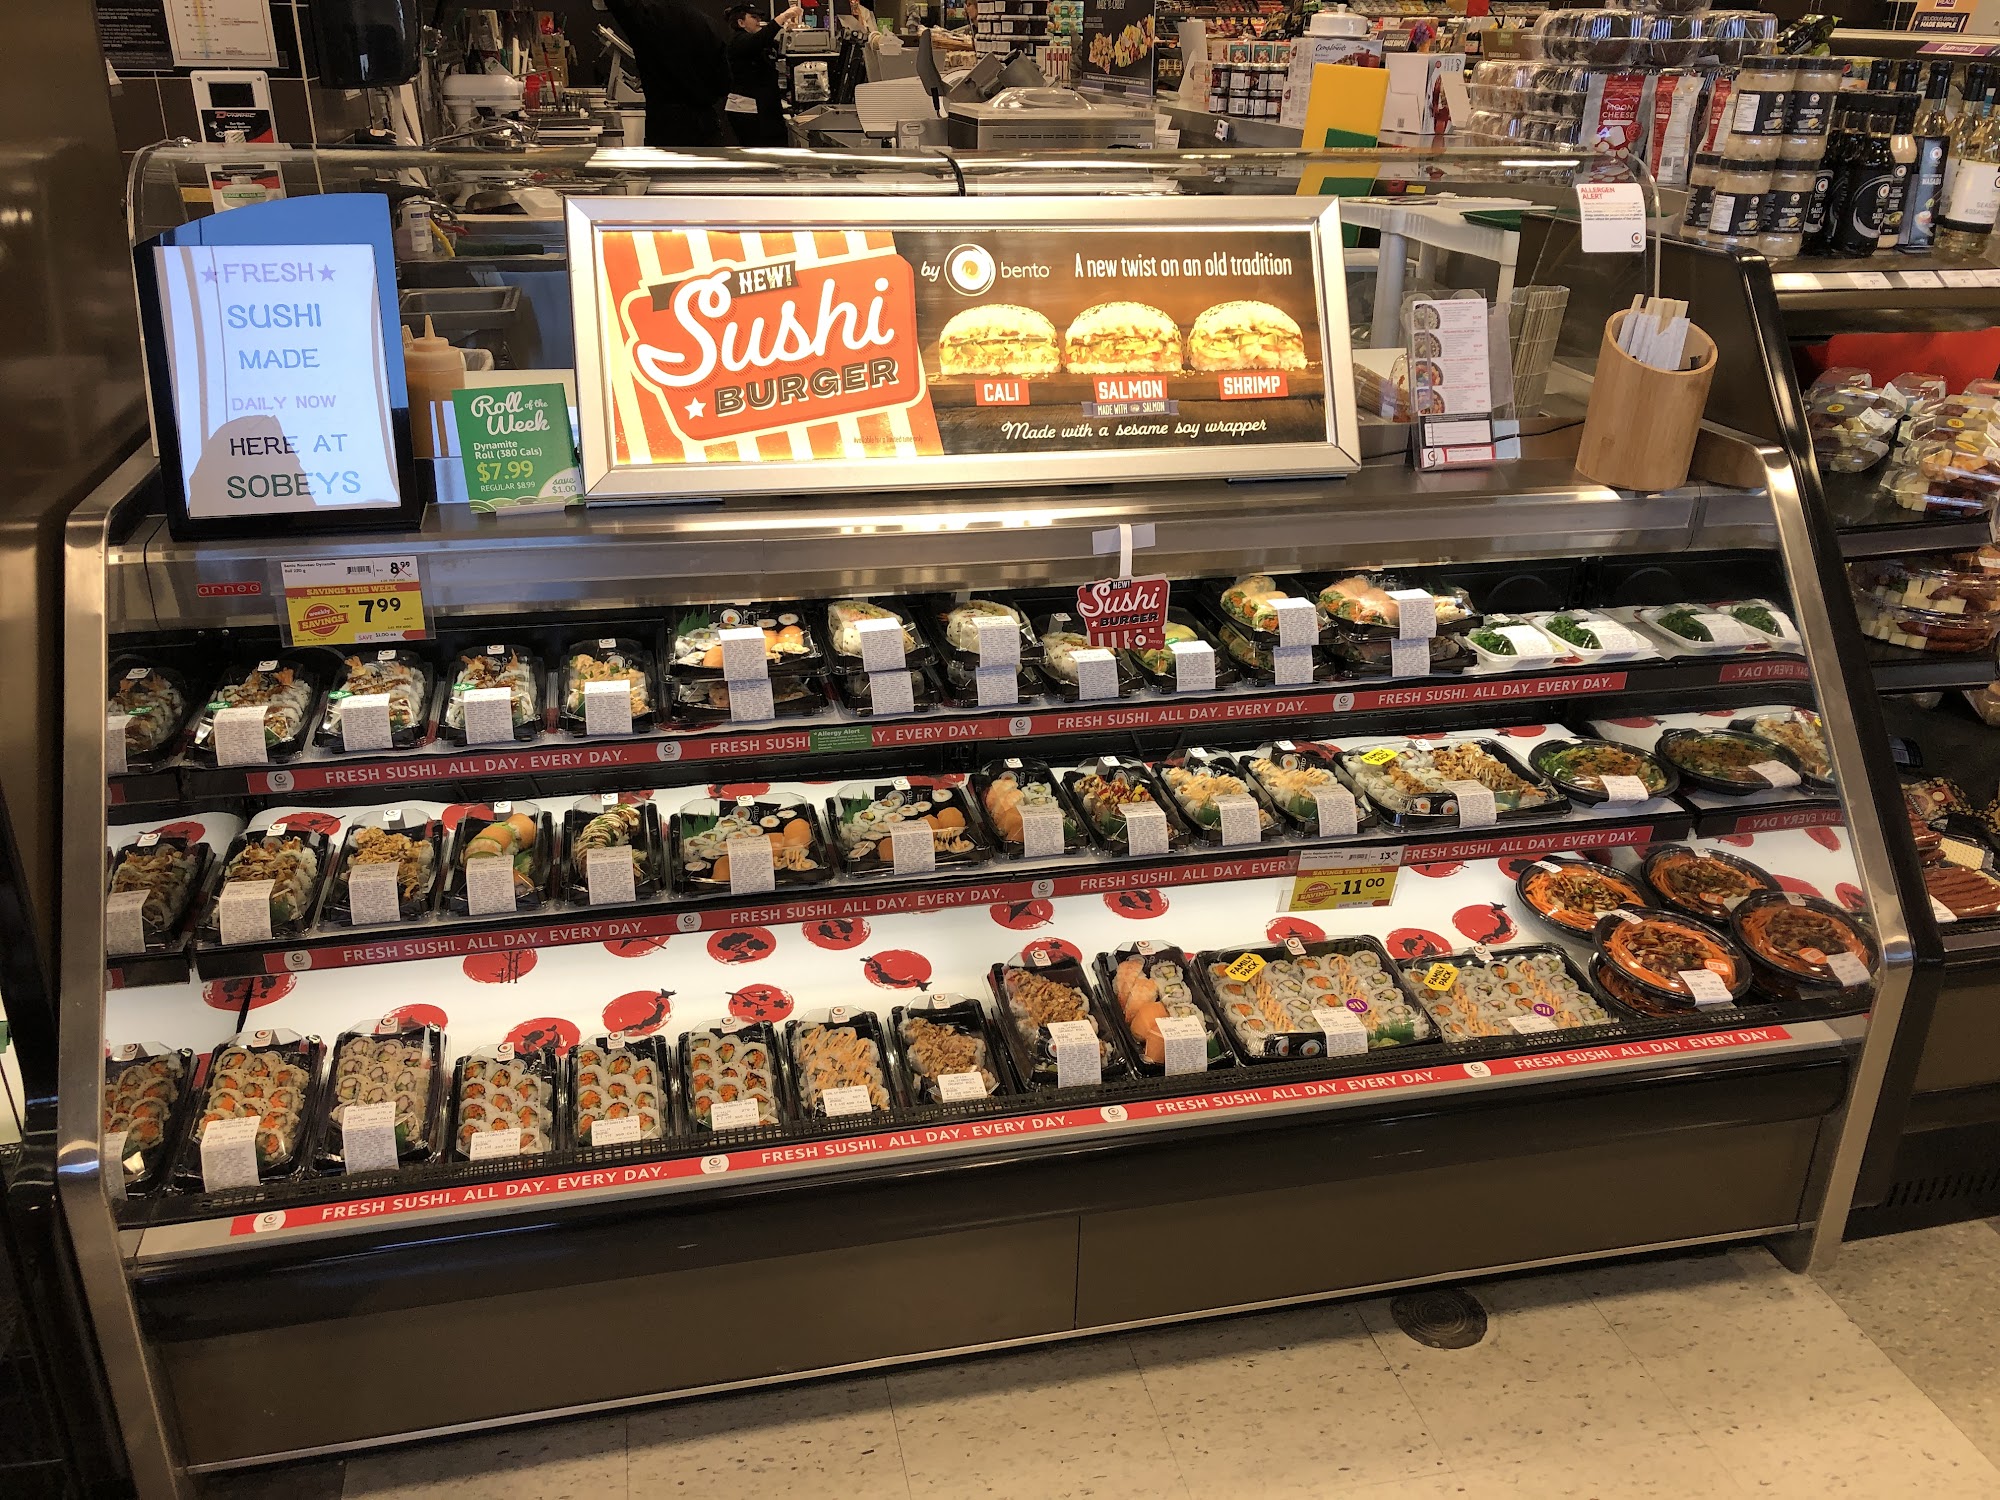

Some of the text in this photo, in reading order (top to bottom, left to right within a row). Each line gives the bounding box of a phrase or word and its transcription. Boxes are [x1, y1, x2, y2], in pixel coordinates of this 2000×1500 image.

[223, 263, 313, 283] FRESH
[921, 261, 1050, 282] by bento
[1075, 252, 1292, 278] A new twist on an old tradition
[739, 264, 793, 295] NEW!
[227, 303, 322, 329] SUSHI
[637, 270, 895, 387] Sushi
[238, 349, 320, 370] MADE
[714, 356, 899, 417] BURGER
[984, 382, 1020, 402] CALI
[1098, 380, 1163, 399] SALMON
[1224, 376, 1280, 394] SHRIMP
[232, 395, 336, 411] DAILY NOW
[471, 391, 548, 418] Roll of the
[1098, 402, 1165, 415] MADE WITH SALMON
[486, 410, 550, 436] Week
[1001, 419, 1268, 440] Made with a sesame soy wrapper
[230, 434, 348, 456] HERE AT
[474, 440, 518, 452] Dynamite
[475, 447, 542, 460] Roll (380 Cals)
[477, 460, 534, 483] $7.99
[226, 470, 362, 499] SOBEYS
[481, 483, 515, 492] REGULAR
[306, 587, 347, 596] SAVINGS
[1113, 581, 1130, 589] NEW!
[1080, 582, 1160, 617] Sushi
[302, 615, 345, 629] SAVINGS
[1100, 612, 1159, 628] BURGER
[1378, 675, 1612, 705] FRESH SUSHI. ALL DAY. EVERY DAY.
[1057, 701, 1308, 729] FRESH SUSHI. ALL DAY. EVERY DAY.
[710, 740, 760, 754] FRESH
[896, 726, 944, 741] EVERY
[948, 723, 983, 738] DAY.
[1364, 750, 1384, 761] FAMILY
[1374, 753, 1390, 762] PACK
[325, 750, 628, 784] FRESH SUSHI. ALL DAY. EVERY DAY.
[1404, 831, 1638, 860] FRESH SUSHI. ALL DAY. EVERY DAY.
[1080, 858, 1296, 890] FRESH SUSHI. ALL DAY. EVERY
[1300, 889, 1335, 900] SAVINGS
[730, 888, 1005, 924] FRESH SUSHI. ALL DAY. EVERY DAY.
[343, 922, 648, 962] FRESH SUSHI. ALL DAY. EVERY DAY.
[1230, 955, 1254, 976] FAMILY
[1240, 962, 1260, 977] PACK
[1428, 965, 1445, 986] FAMILY
[1440, 971, 1452, 986] PACK
[1536, 1006, 1550, 1015] $11
[1514, 1029, 1777, 1070] FRESH SUSHI. ALL DAY. EVERY DAY.
[1156, 1071, 1441, 1114] FRESH SUSHI. ALL DAY. EVERY DAY.
[761, 1116, 1073, 1164] FRESH SUSHI. ALL DAY. EVERY DAY.
[322, 1166, 668, 1221] FRESH SUSHI. ALL DAY. EVERY DAY.
